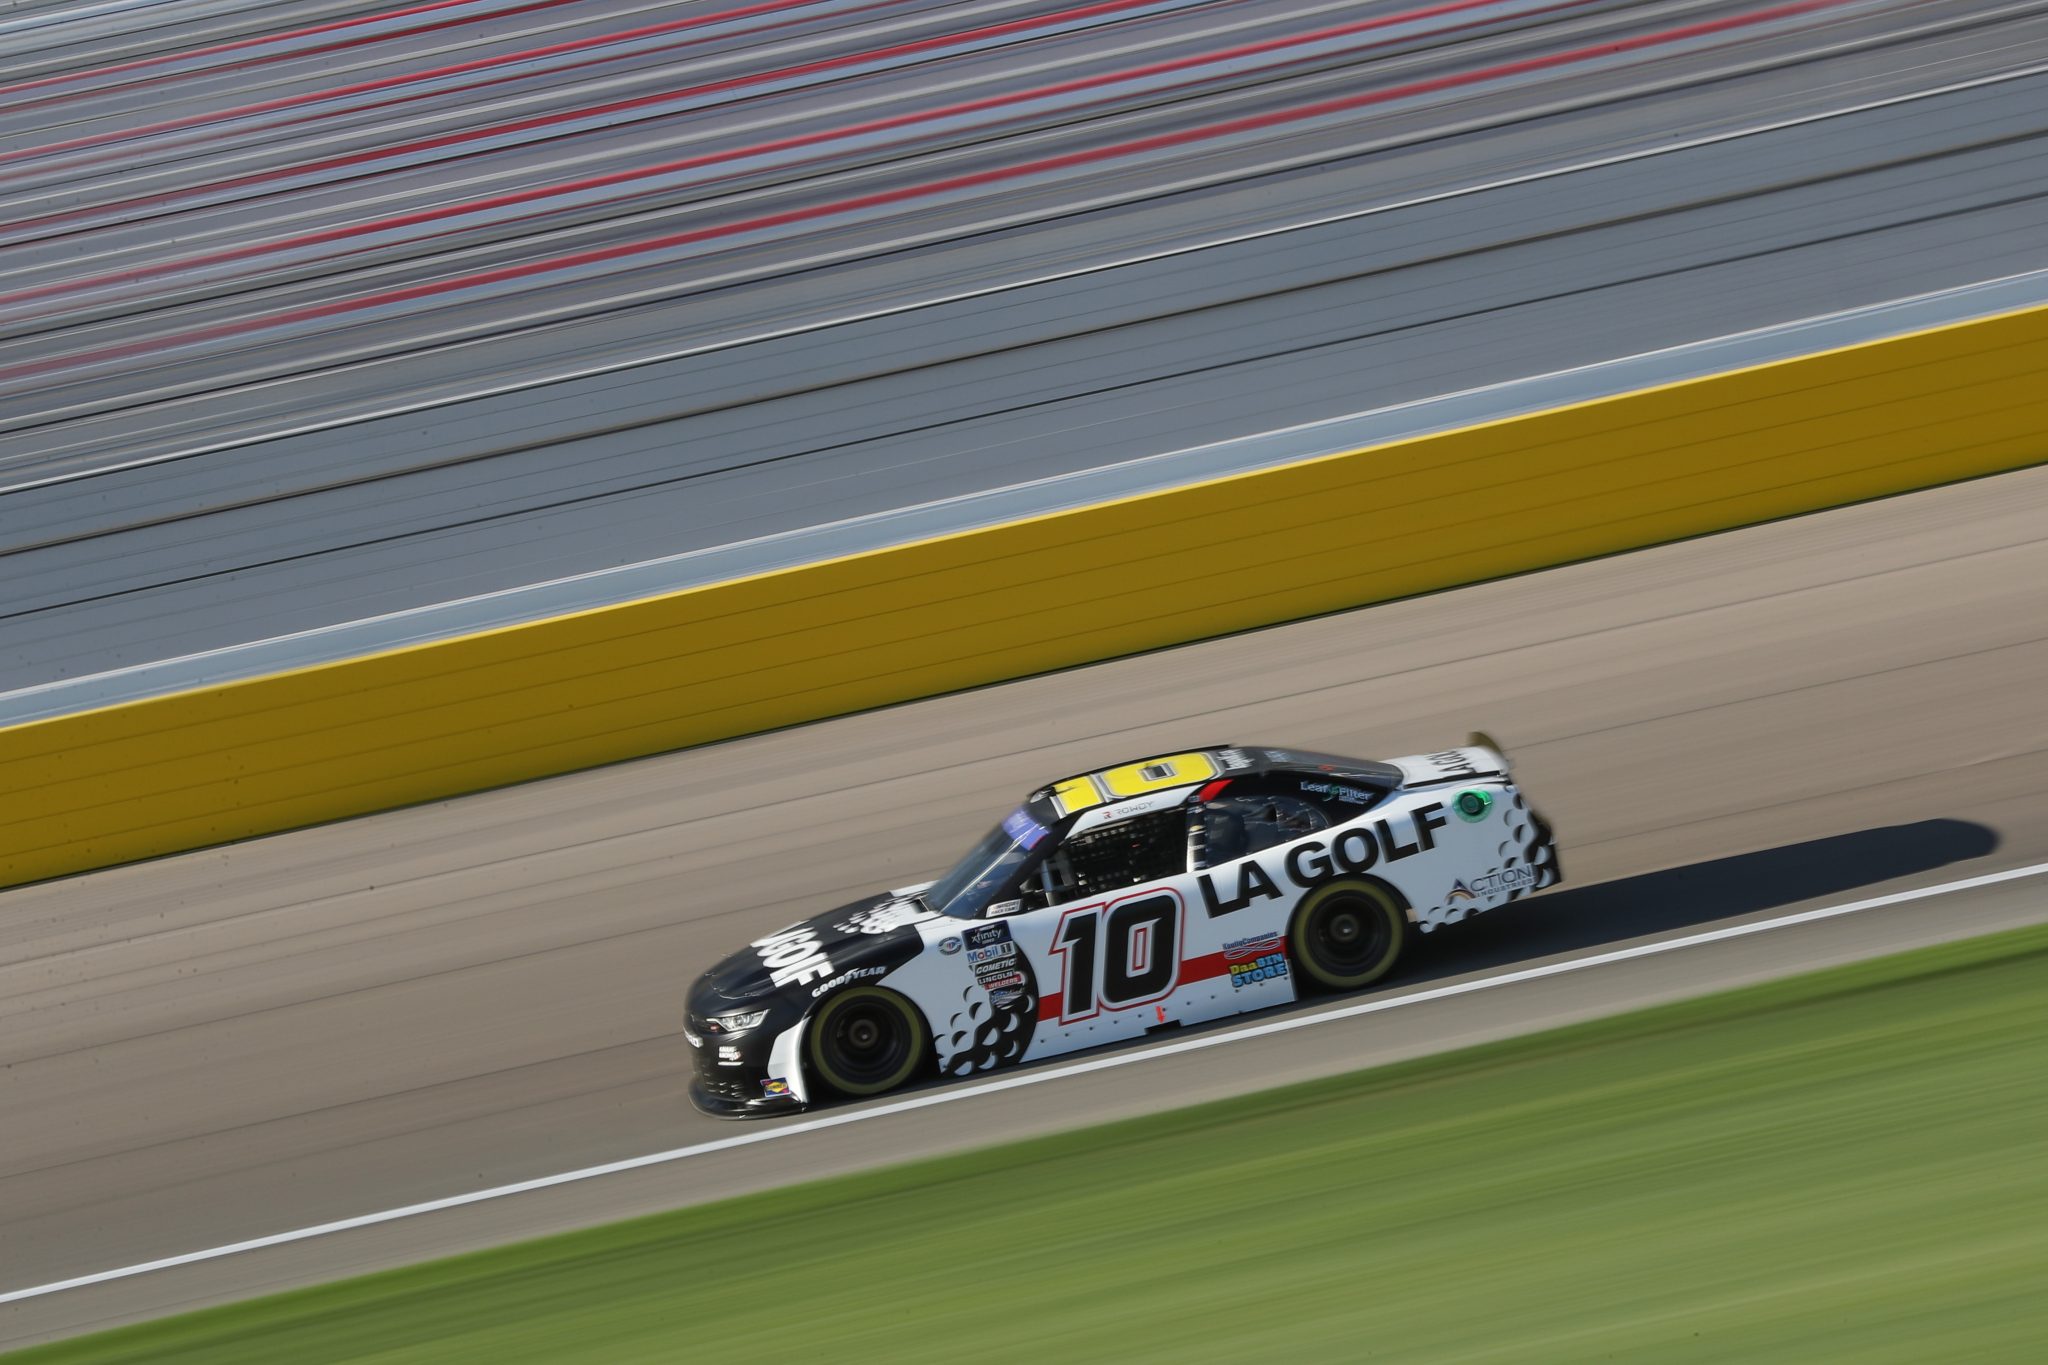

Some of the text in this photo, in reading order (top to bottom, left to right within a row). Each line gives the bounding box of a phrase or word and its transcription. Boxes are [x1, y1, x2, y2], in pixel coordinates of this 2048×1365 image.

[1300, 781, 1329, 793] Leaf
[1339, 786, 1373, 801] Filter
[1116, 801, 1155, 815] ROWDY
[1197, 801, 1447, 919] LA GOLF
[1449, 865, 1532, 901] ACTION
[971, 929, 1002, 943] xfinity
[967, 949, 998, 963] Mobil
[1050, 888, 1184, 1025] 10
[976, 959, 1016, 974] COMETIC
[1231, 962, 1287, 987] STORE
[812, 966, 887, 997] GOODYEAR
[979, 971, 1013, 984] LINCOLN
[989, 978, 1018, 989] WELDERS
